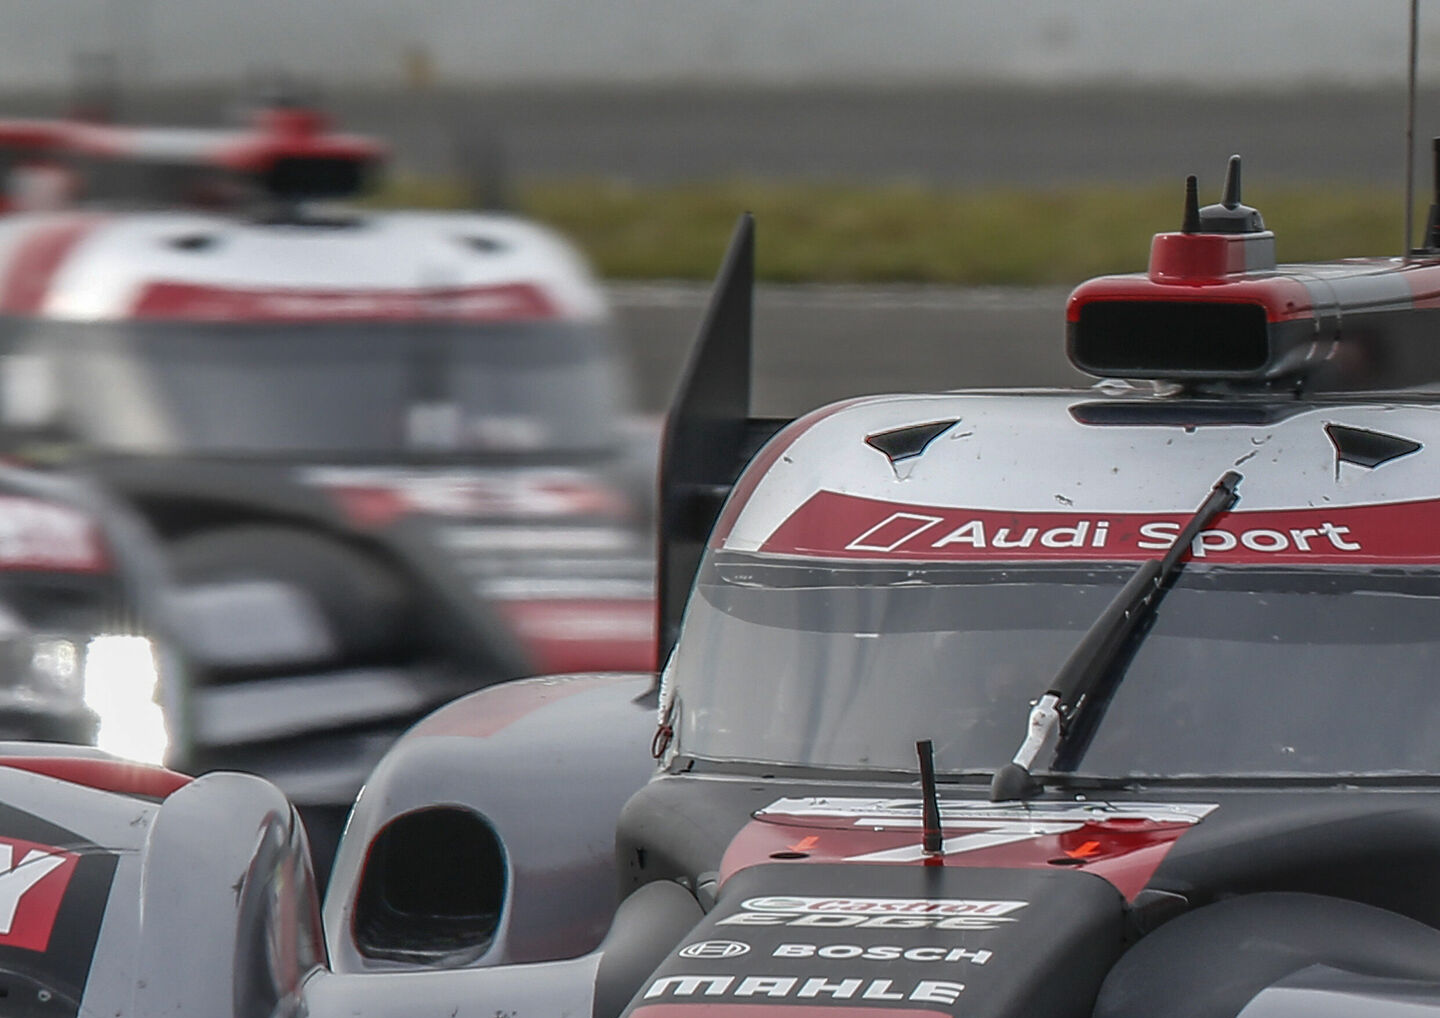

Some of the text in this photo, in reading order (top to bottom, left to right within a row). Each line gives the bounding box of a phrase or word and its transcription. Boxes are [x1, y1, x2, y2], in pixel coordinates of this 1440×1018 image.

[931, 519, 1361, 558] Audi Sport
[842, 817, 1086, 863] 7
[806, 899, 1000, 915] Castrol
[715, 912, 1019, 931] EDGE
[772, 943, 993, 966] BOSCH
[642, 975, 966, 1006] MAHLE
